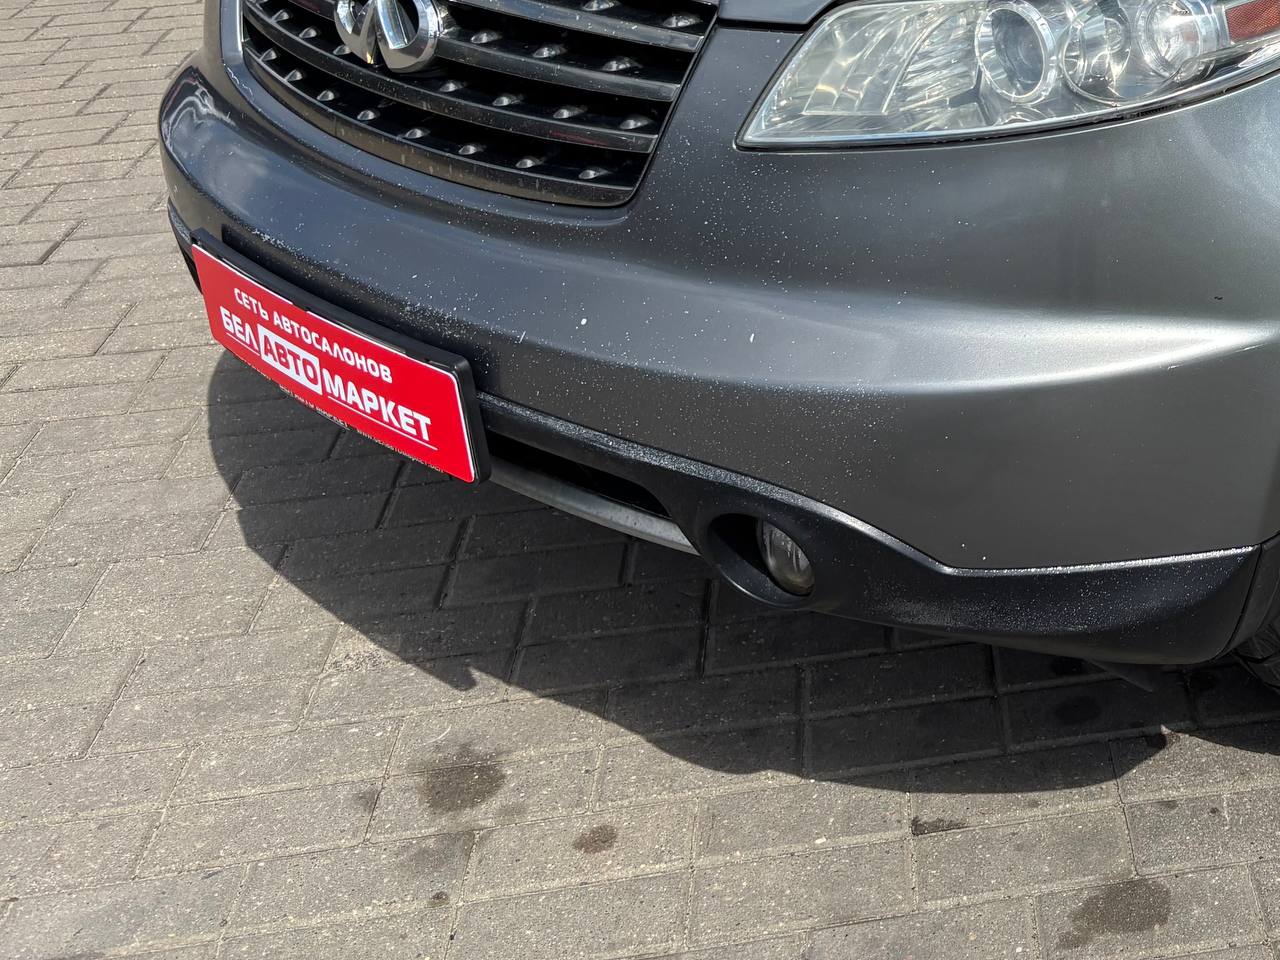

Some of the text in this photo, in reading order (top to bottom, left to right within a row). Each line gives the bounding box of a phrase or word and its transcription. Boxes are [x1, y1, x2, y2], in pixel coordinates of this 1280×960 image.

[220, 306, 431, 441] БЕЛАВТОМАРКЕТ
[234, 288, 393, 384] СЕТЬ АВТОСАЛОНОВ
